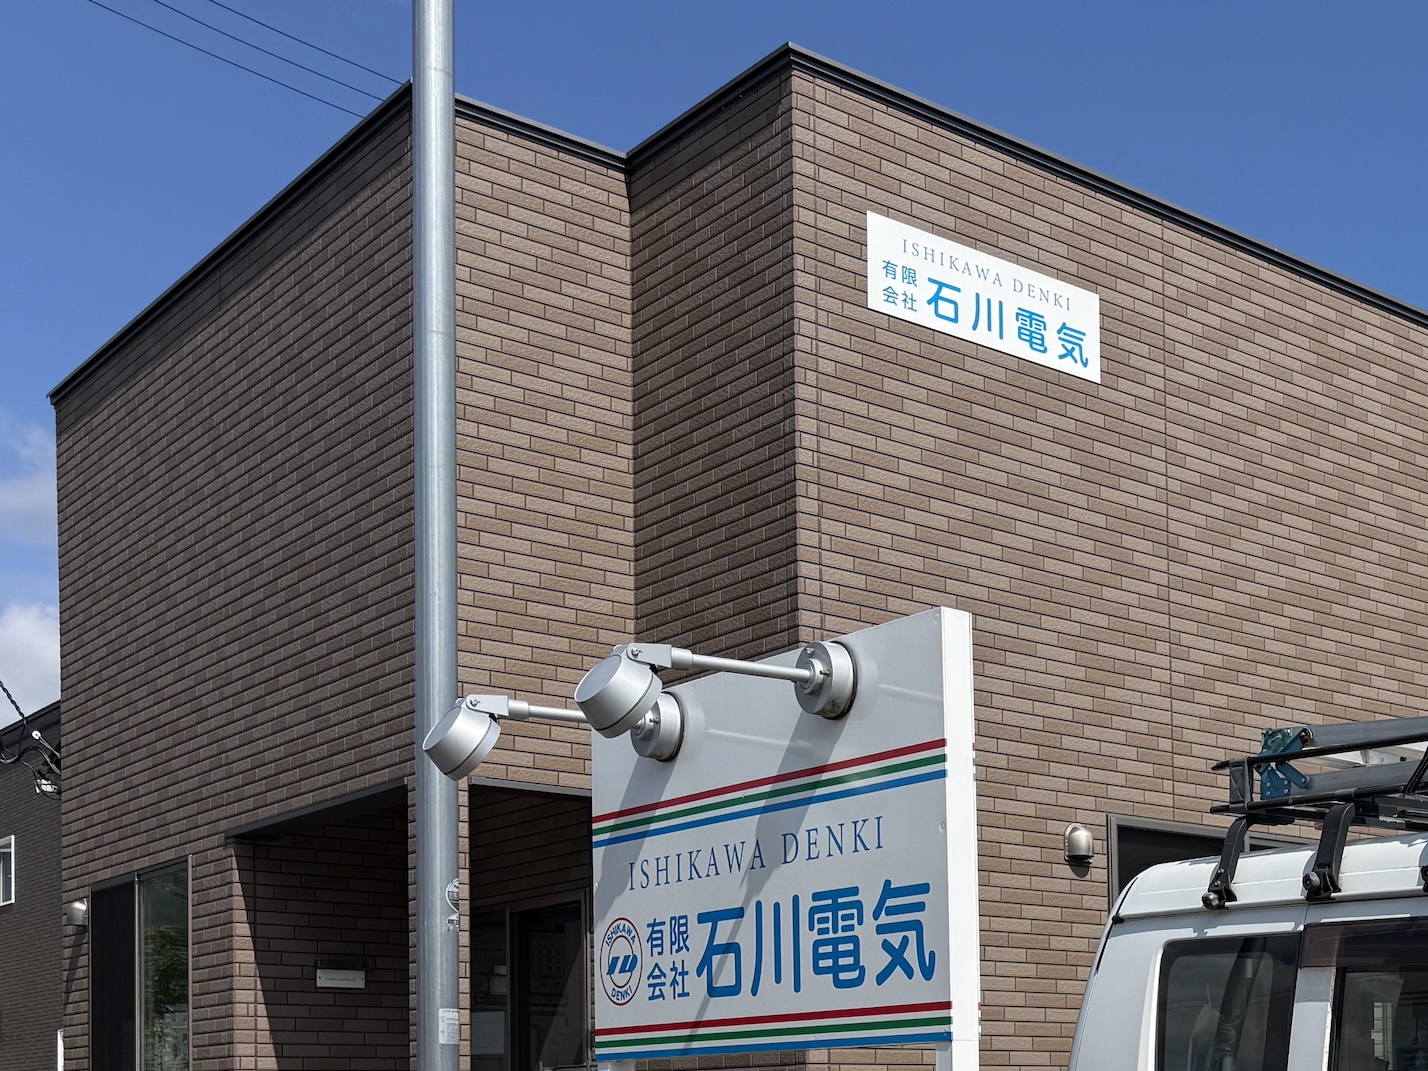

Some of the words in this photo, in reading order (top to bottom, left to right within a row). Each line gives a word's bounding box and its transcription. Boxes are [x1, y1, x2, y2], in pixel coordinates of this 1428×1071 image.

[882, 260, 918, 287] 有限
[902, 238, 1003, 287] ISHIKAWA
[1012, 277, 1071, 311] DENKI
[882, 285, 918, 312] 会社
[927, 277, 1089, 368] 石川電気
[628, 838, 766, 891] ISHIKAWA
[781, 815, 883, 866] DENKI
[605, 923, 636, 947] ISHIKAWA
[646, 915, 690, 957] 有限
[696, 879, 936, 998] 石川電気
[611, 985, 633, 1001] DENKI
[646, 960, 690, 1001] 会社
